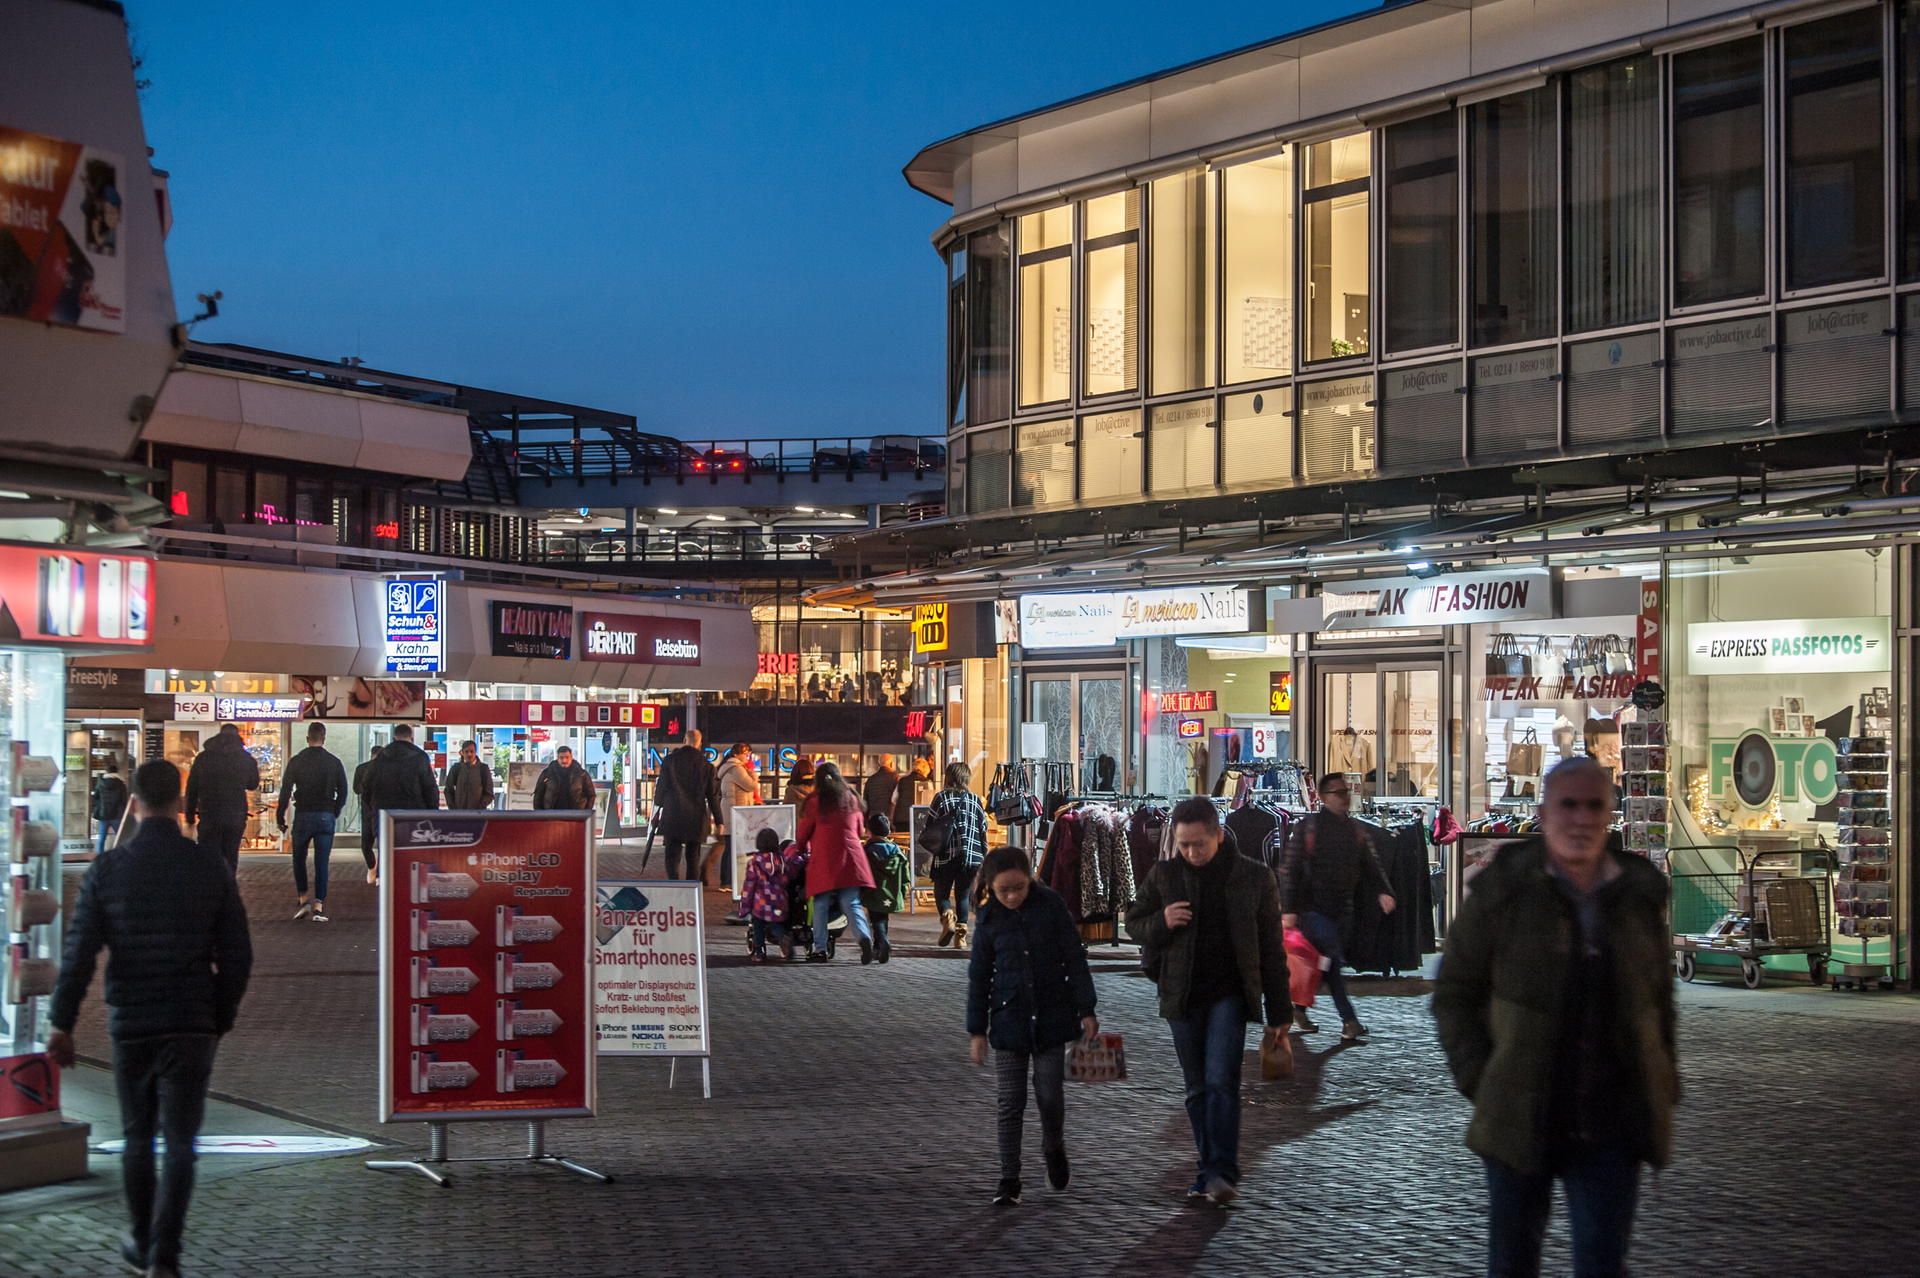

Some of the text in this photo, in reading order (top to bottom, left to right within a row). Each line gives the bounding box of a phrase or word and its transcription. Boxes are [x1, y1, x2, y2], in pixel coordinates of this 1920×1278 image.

[1808, 312, 1868, 333] Job@ctive
[1679, 324, 1766, 349] www.jobactive.de
[1402, 369, 1448, 391] Job@ctive
[1306, 381, 1371, 401] www.jobactive.de
[1022, 424, 1072, 442] www.jobactive.de
[1096, 416, 1130, 433] Job@ctive
[1433, 580, 1530, 612] FASHION
[1079, 605, 1112, 617] Nails
[1201, 591, 1245, 620] Nails
[388, 614, 437, 630] Schuh &
[396, 643, 429, 654] Krahn
[655, 638, 698, 658] Reisebüro
[1710, 634, 1863, 657] EXPRESS PASSFOTOS
[70, 669, 119, 689] Freestyle
[1491, 677, 1542, 700] PEAK
[236, 710, 299, 718] Schlüsseldienst
[1180, 723, 1200, 736] OPEN
[1255, 730, 1275, 753] 3 90
[1710, 731, 1838, 807] FOTO
[481, 852, 560, 867] iPhone LCD
[482, 868, 541, 884] Display
[514, 886, 571, 898] Reparatur
[633, 928, 655, 946] für
[596, 948, 697, 969] Smartphones
[598, 980, 697, 991] optimaler Displayschutz
[607, 993, 686, 1002] Kratz- und Stoßfest
[595, 1004, 699, 1016] Sofort Beklebung möglich
